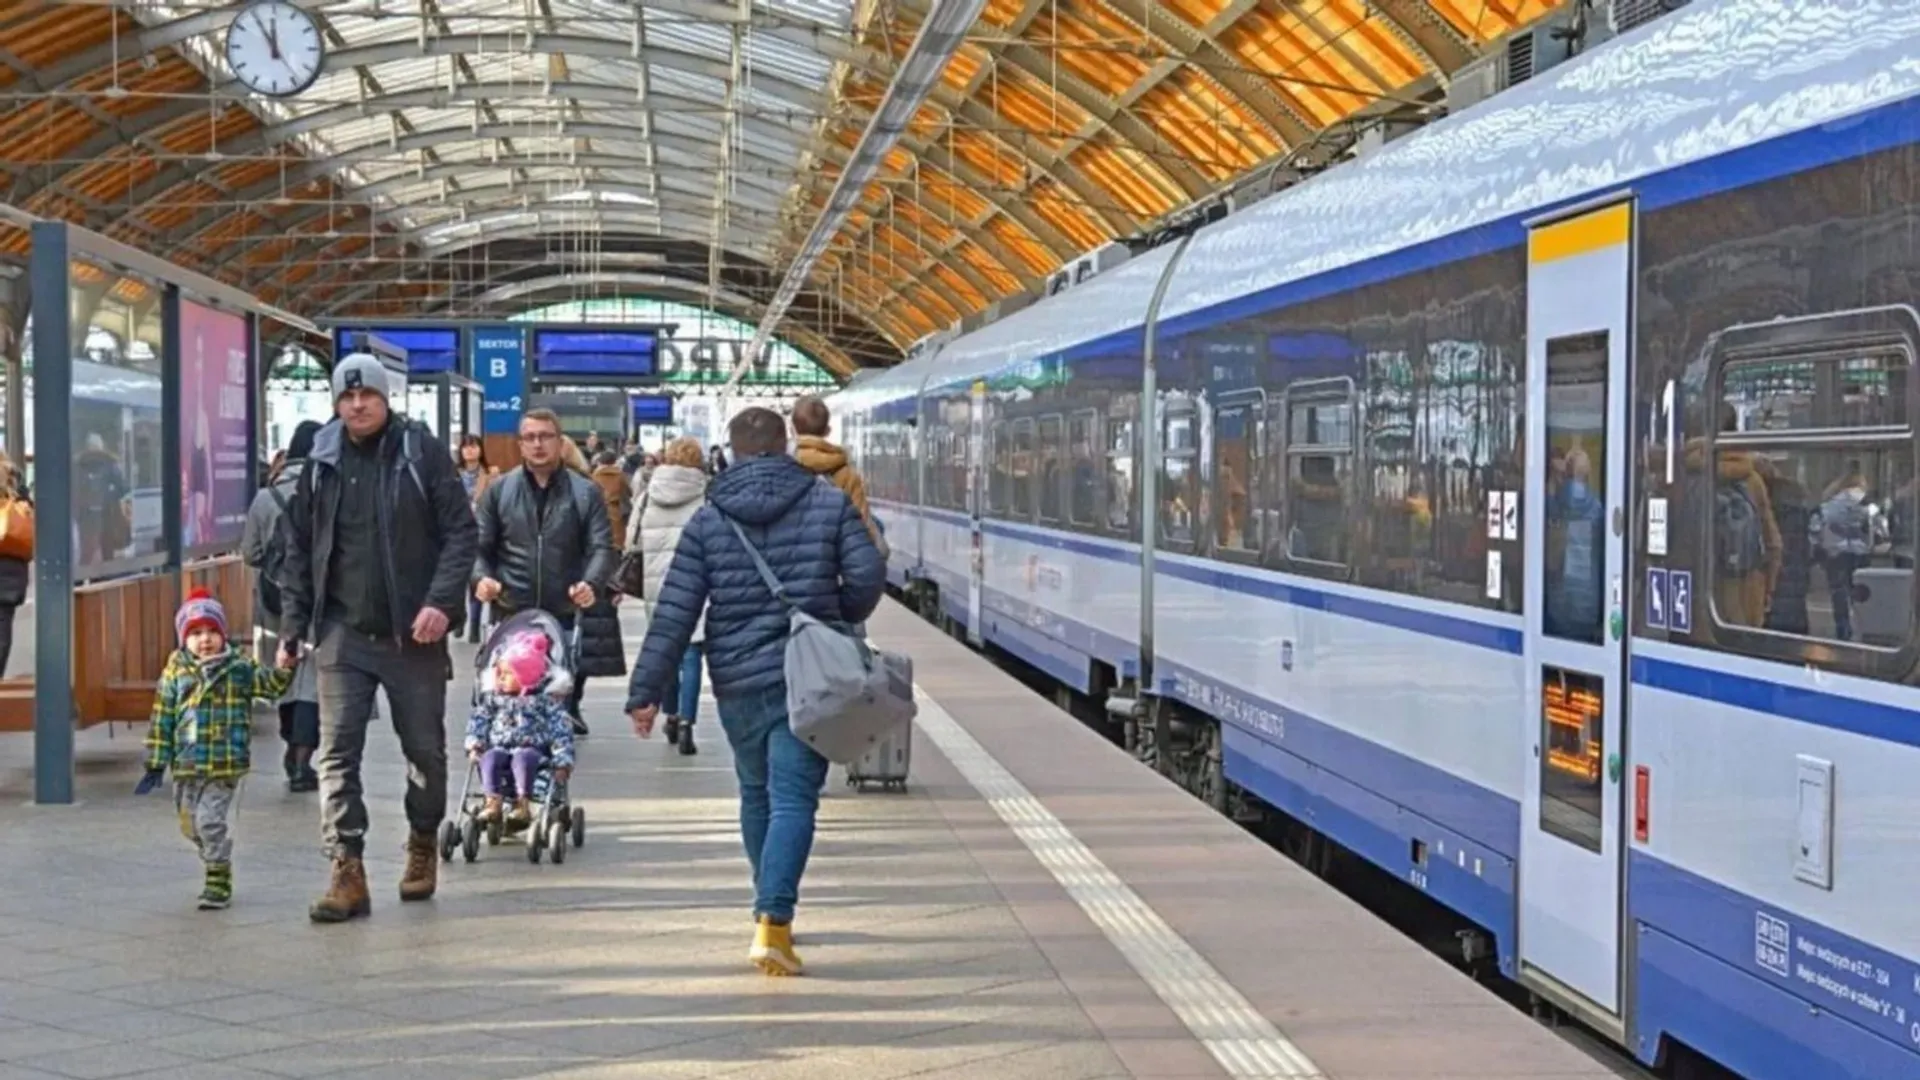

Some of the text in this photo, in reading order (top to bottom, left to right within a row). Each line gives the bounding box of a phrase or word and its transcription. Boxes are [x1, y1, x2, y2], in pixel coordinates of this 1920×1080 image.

[479, 340, 518, 349] SEKTOR
[490, 358, 507, 378] B
[510, 396, 521, 411] 2
[1662, 379, 1675, 484] 1
